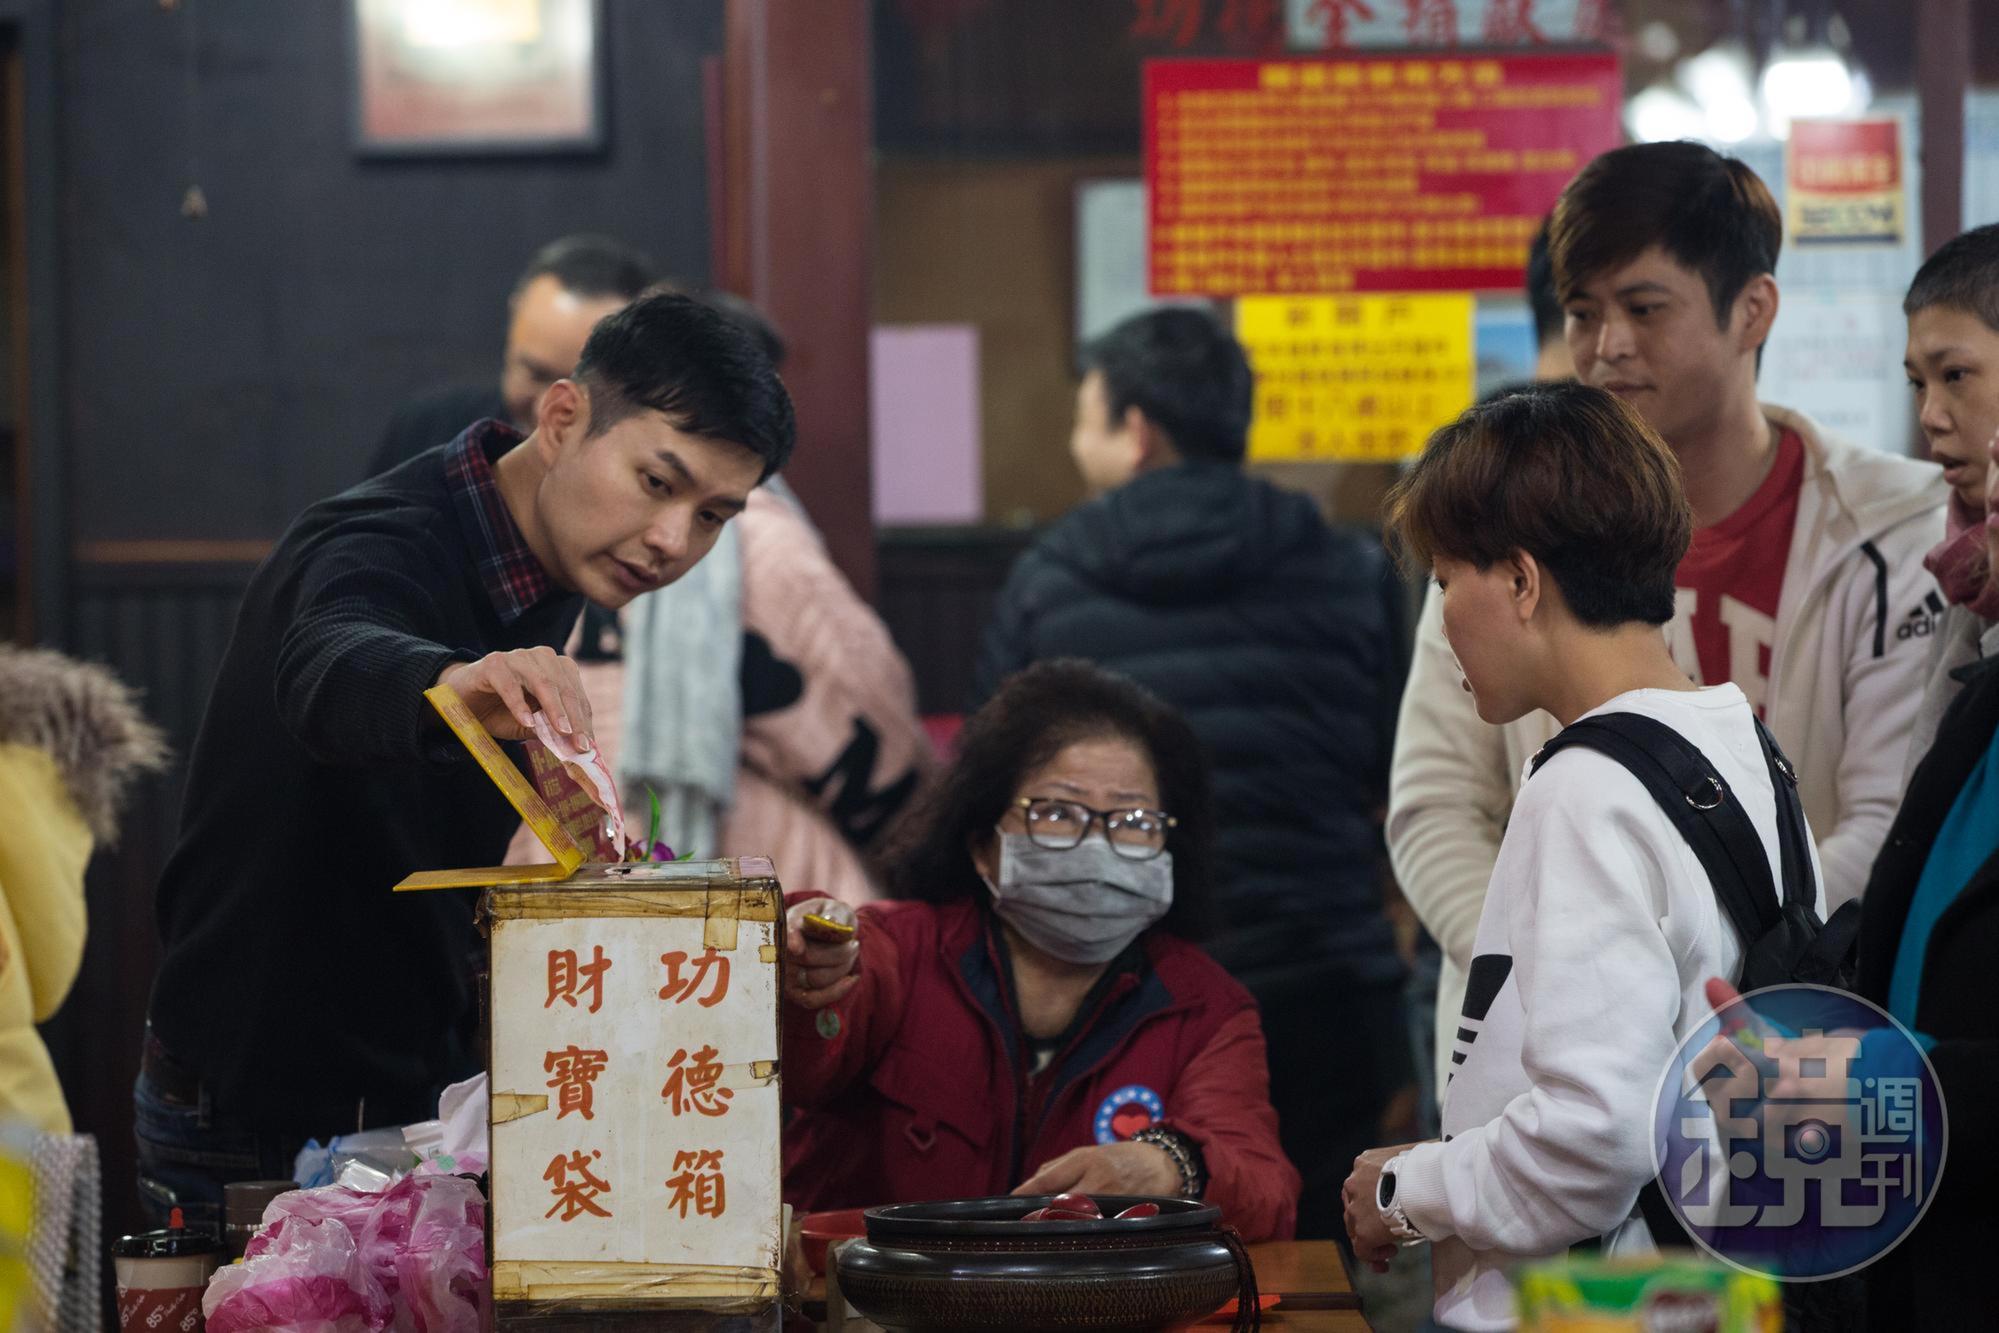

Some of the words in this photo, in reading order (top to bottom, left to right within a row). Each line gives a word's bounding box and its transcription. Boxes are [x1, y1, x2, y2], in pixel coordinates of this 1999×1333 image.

[1897, 616, 1936, 641] adi
[543, 945, 613, 1222] 財寶袋
[659, 946, 734, 1219] 功德箱
